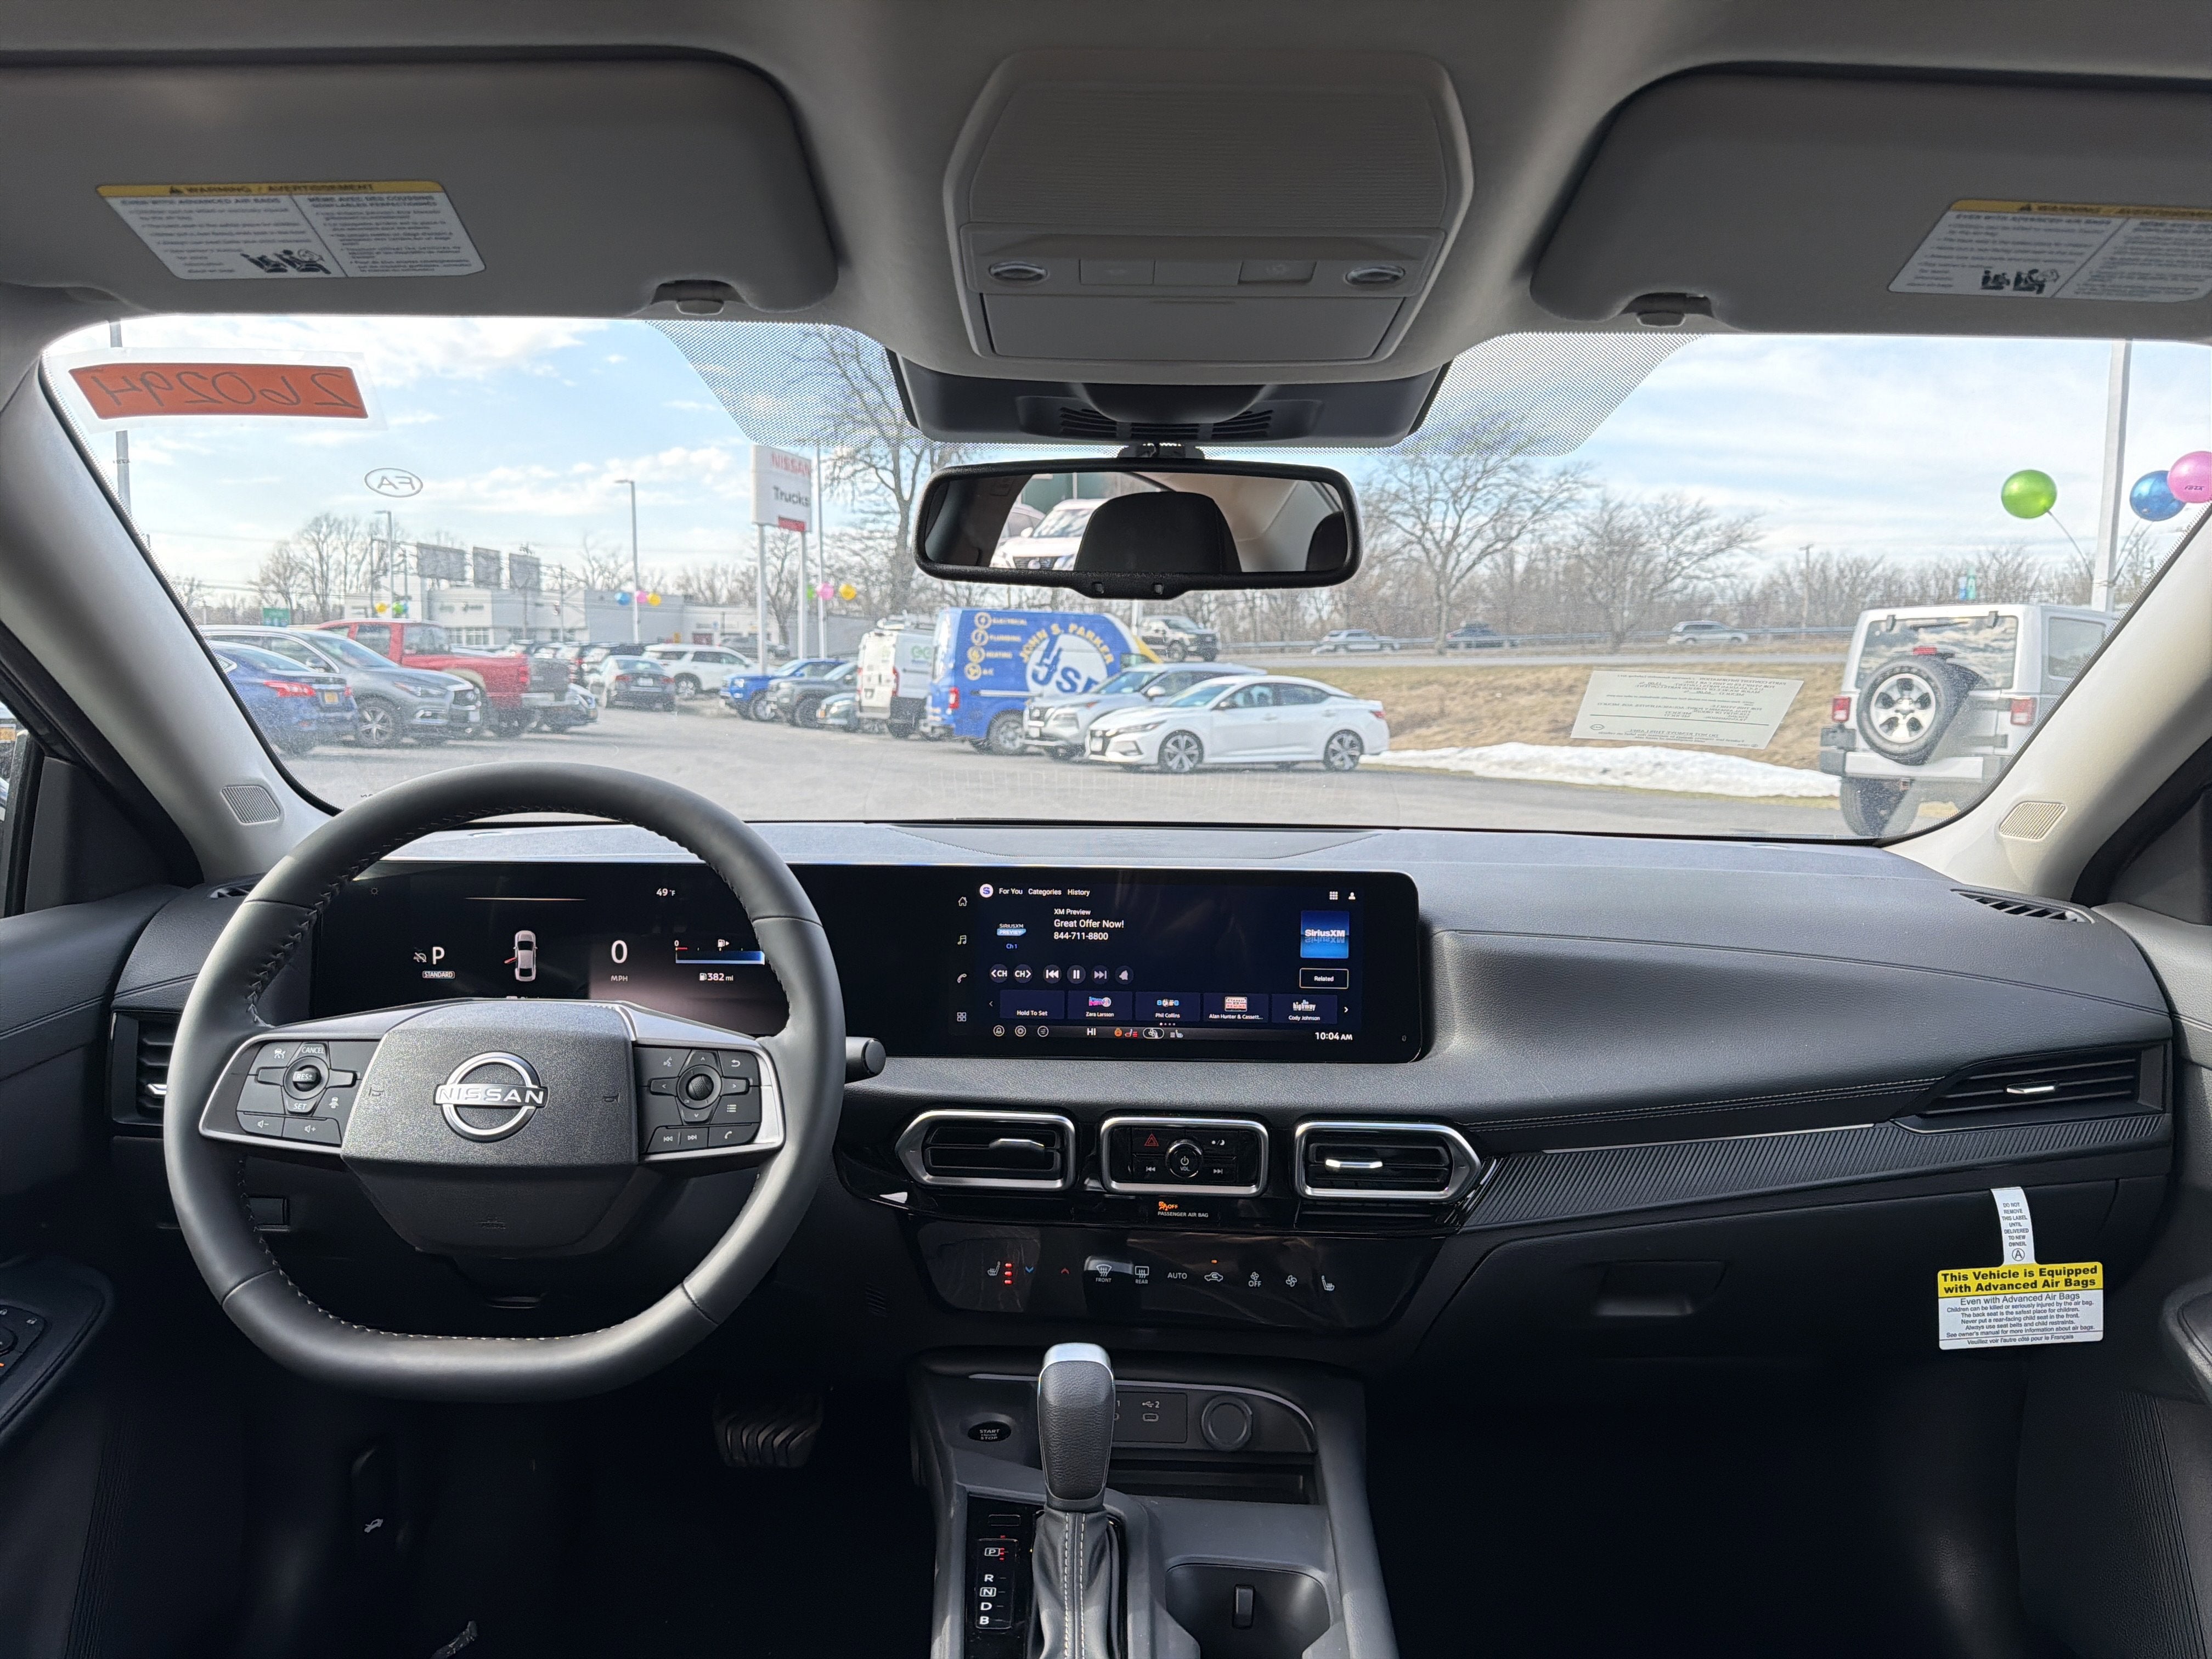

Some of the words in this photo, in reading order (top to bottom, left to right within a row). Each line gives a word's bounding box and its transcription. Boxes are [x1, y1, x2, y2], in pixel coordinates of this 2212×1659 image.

[772, 453, 811, 476] NISSAN
[774, 486, 810, 507] Trucks
[1019, 629, 1048, 663] JOHN
[1069, 623, 1114, 664] PARKER
[1028, 888, 1062, 896] Categories
[1079, 919, 1100, 928] Offer
[1103, 920, 1124, 928] Now!
[1054, 932, 1109, 940] 844-711-8800
[1305, 929, 1345, 938] SiriusXM
[432, 946, 445, 965] P
[611, 940, 628, 963] 0
[707, 973, 725, 981] 382
[1293, 1002, 1316, 1011] highway
[1087, 1028, 1096, 1036] HI
[1315, 1032, 1339, 1040] 10:04
[439, 1087, 544, 1104] NISSAN
[1941, 1272, 1968, 1282] This
[1972, 1269, 2019, 1280] Vehicle
[2023, 1268, 2034, 1277] is
[2039, 1265, 2097, 1279] Equipped
[1943, 1283, 1971, 1294] with
[1974, 1279, 2037, 1292] Advanced
[2041, 1278, 2060, 1288] Air
[2064, 1276, 2096, 1289] Bags
[1960, 1296, 1981, 1306] Even
[1983, 1296, 2000, 1304] with
[2002, 1293, 2042, 1304] Advanced
[2044, 1293, 2056, 1301] Air
[2059, 1291, 2080, 1302] Bags
[2011, 1302, 2035, 1310] seriously
[984, 1573, 994, 1582] R
[980, 1601, 992, 1611] D
[979, 1616, 990, 1625] B
